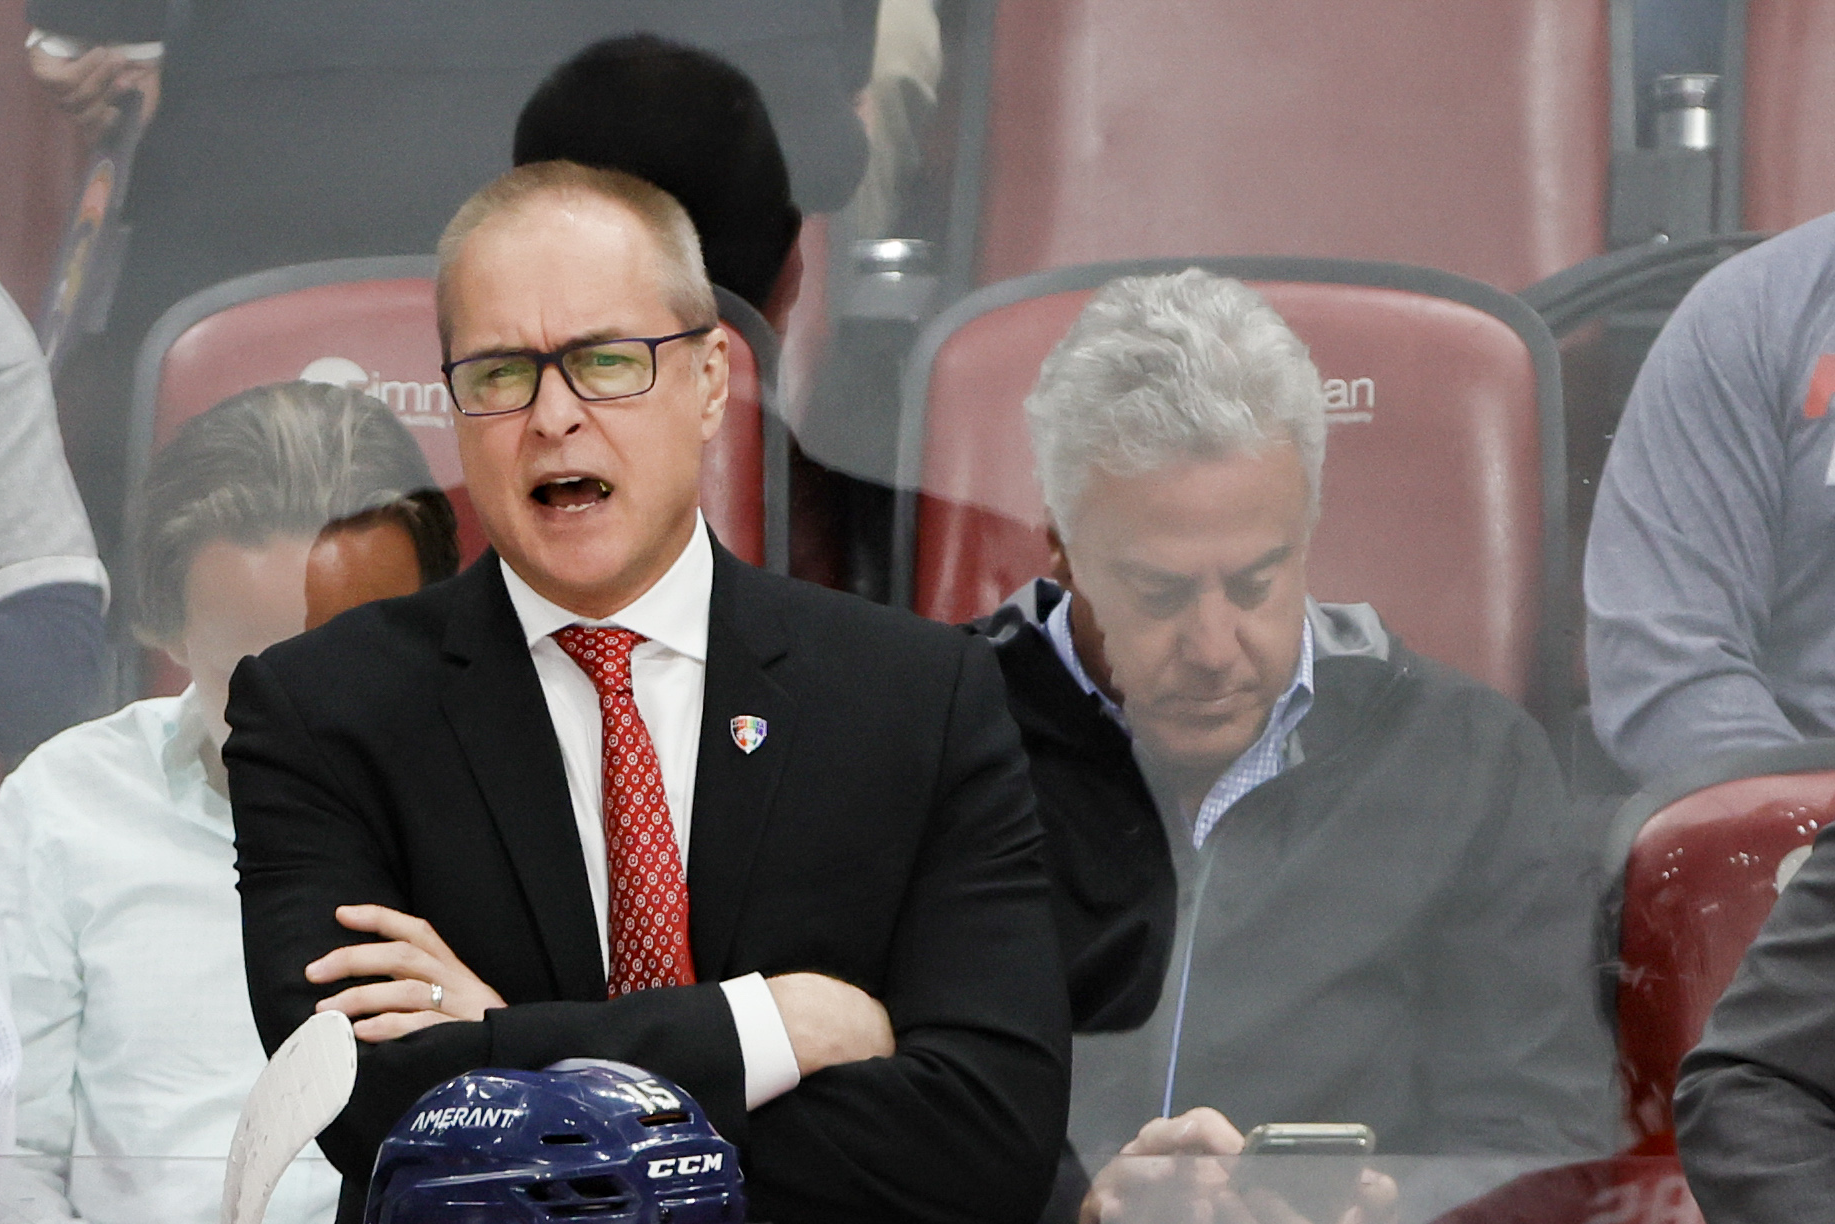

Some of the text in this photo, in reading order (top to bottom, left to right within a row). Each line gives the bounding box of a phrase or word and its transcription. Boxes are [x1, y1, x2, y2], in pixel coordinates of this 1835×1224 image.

[616, 1079, 683, 1114] 15
[410, 1106, 515, 1132] AMERANT
[647, 1152, 724, 1179] CCM
